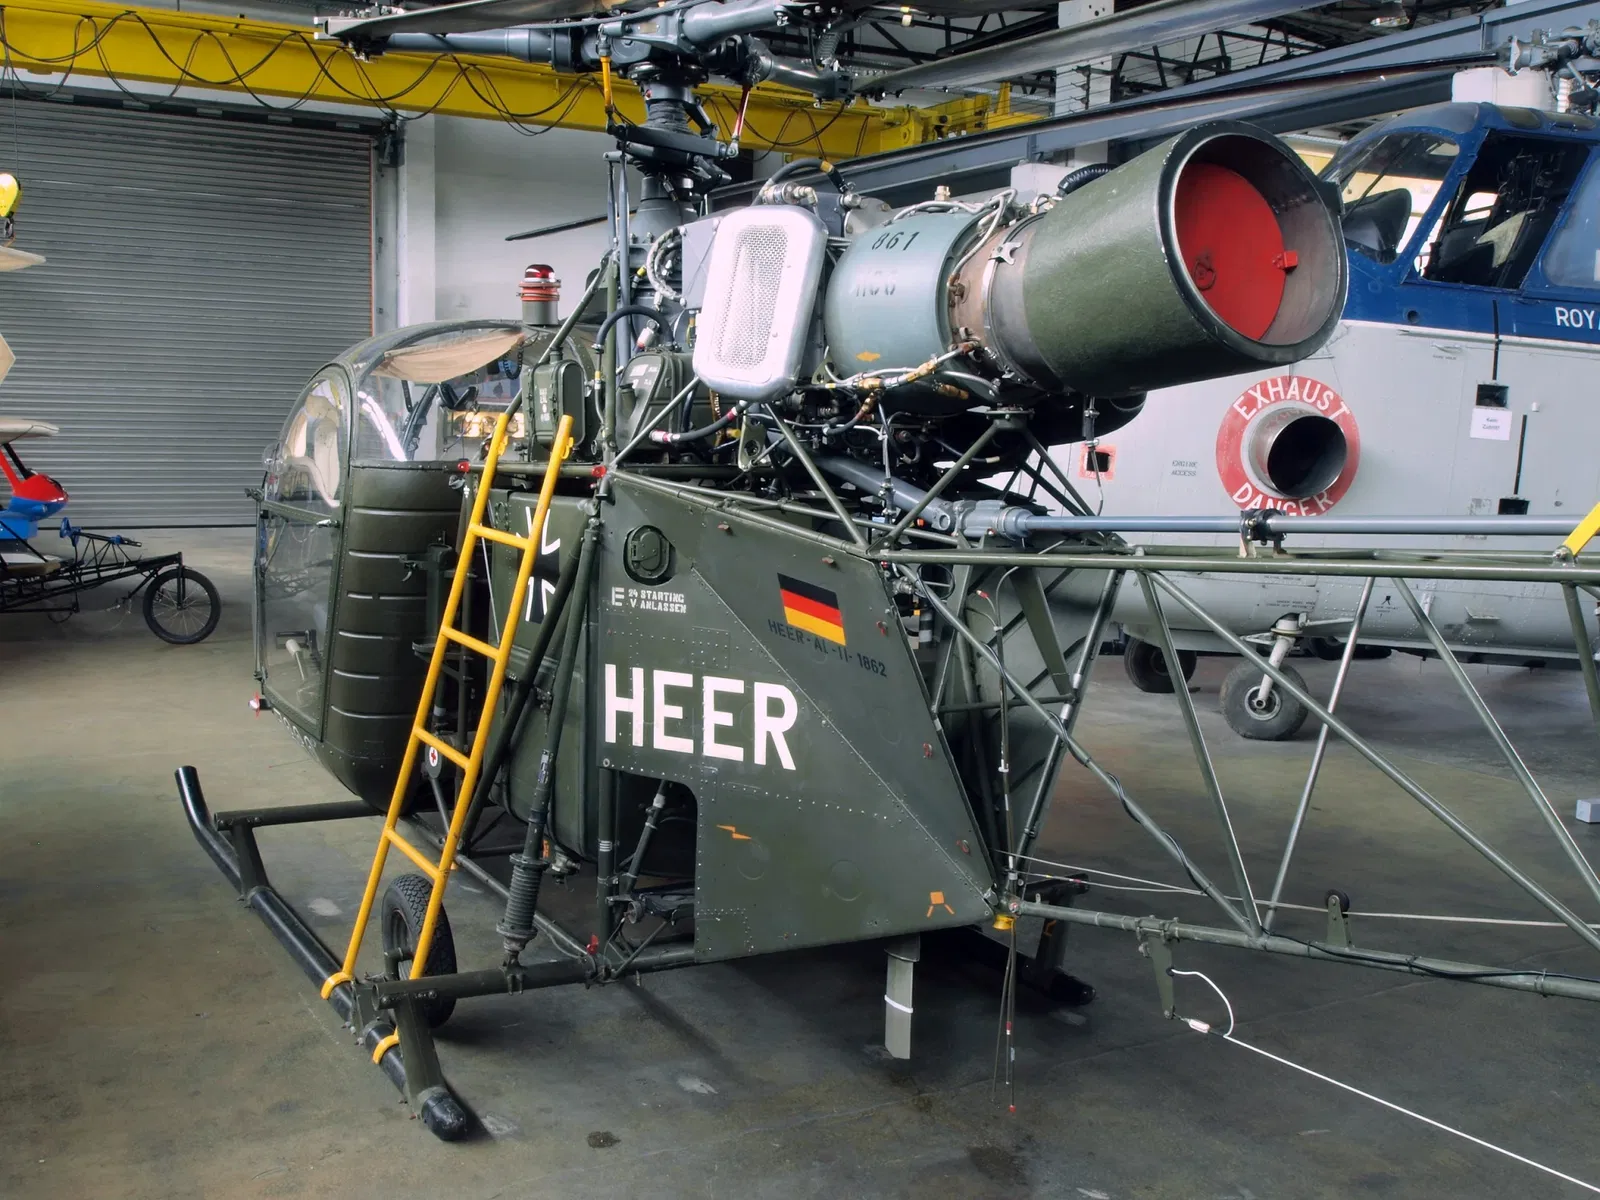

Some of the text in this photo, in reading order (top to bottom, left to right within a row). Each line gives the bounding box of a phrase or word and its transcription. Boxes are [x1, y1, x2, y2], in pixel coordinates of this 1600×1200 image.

[872, 231, 920, 251] 861
[1555, 306, 1600, 331] ROY
[1232, 377, 1351, 420] EXHAUST
[629, 598, 687, 614] V ANLASSEN
[640, 589, 685, 604] STARTING
[605, 663, 798, 770] HEER
